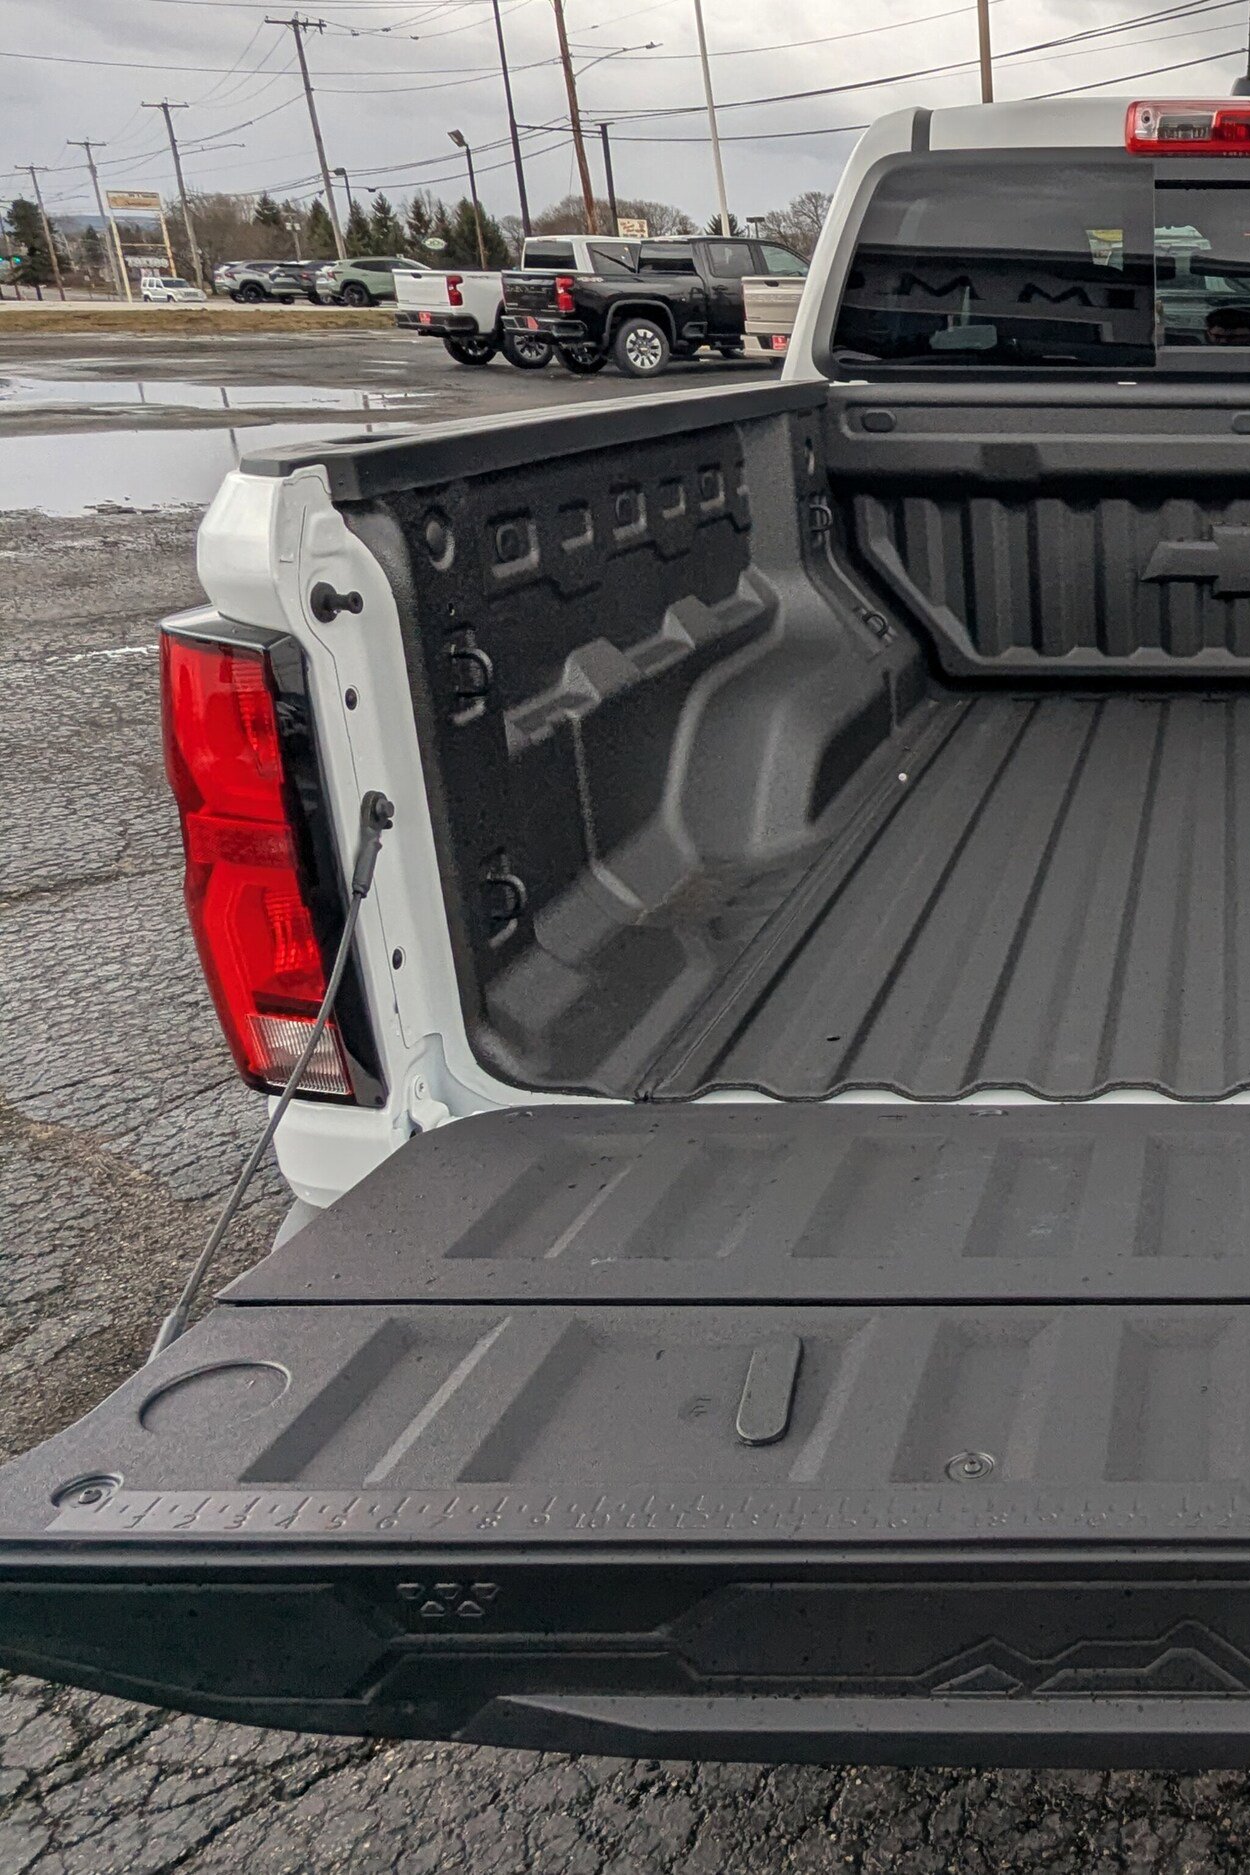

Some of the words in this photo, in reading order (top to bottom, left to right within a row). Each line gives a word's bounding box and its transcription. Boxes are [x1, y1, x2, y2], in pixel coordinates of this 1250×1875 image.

[124, 1514, 146, 1529] 1
[172, 1513, 200, 1528] 2
[224, 1513, 252, 1528] 3
[274, 1513, 302, 1528] 4
[325, 1513, 348, 1528] 5
[376, 1513, 400, 1528] 6
[476, 1513, 503, 1528] 8
[528, 1513, 552, 1528] 9
